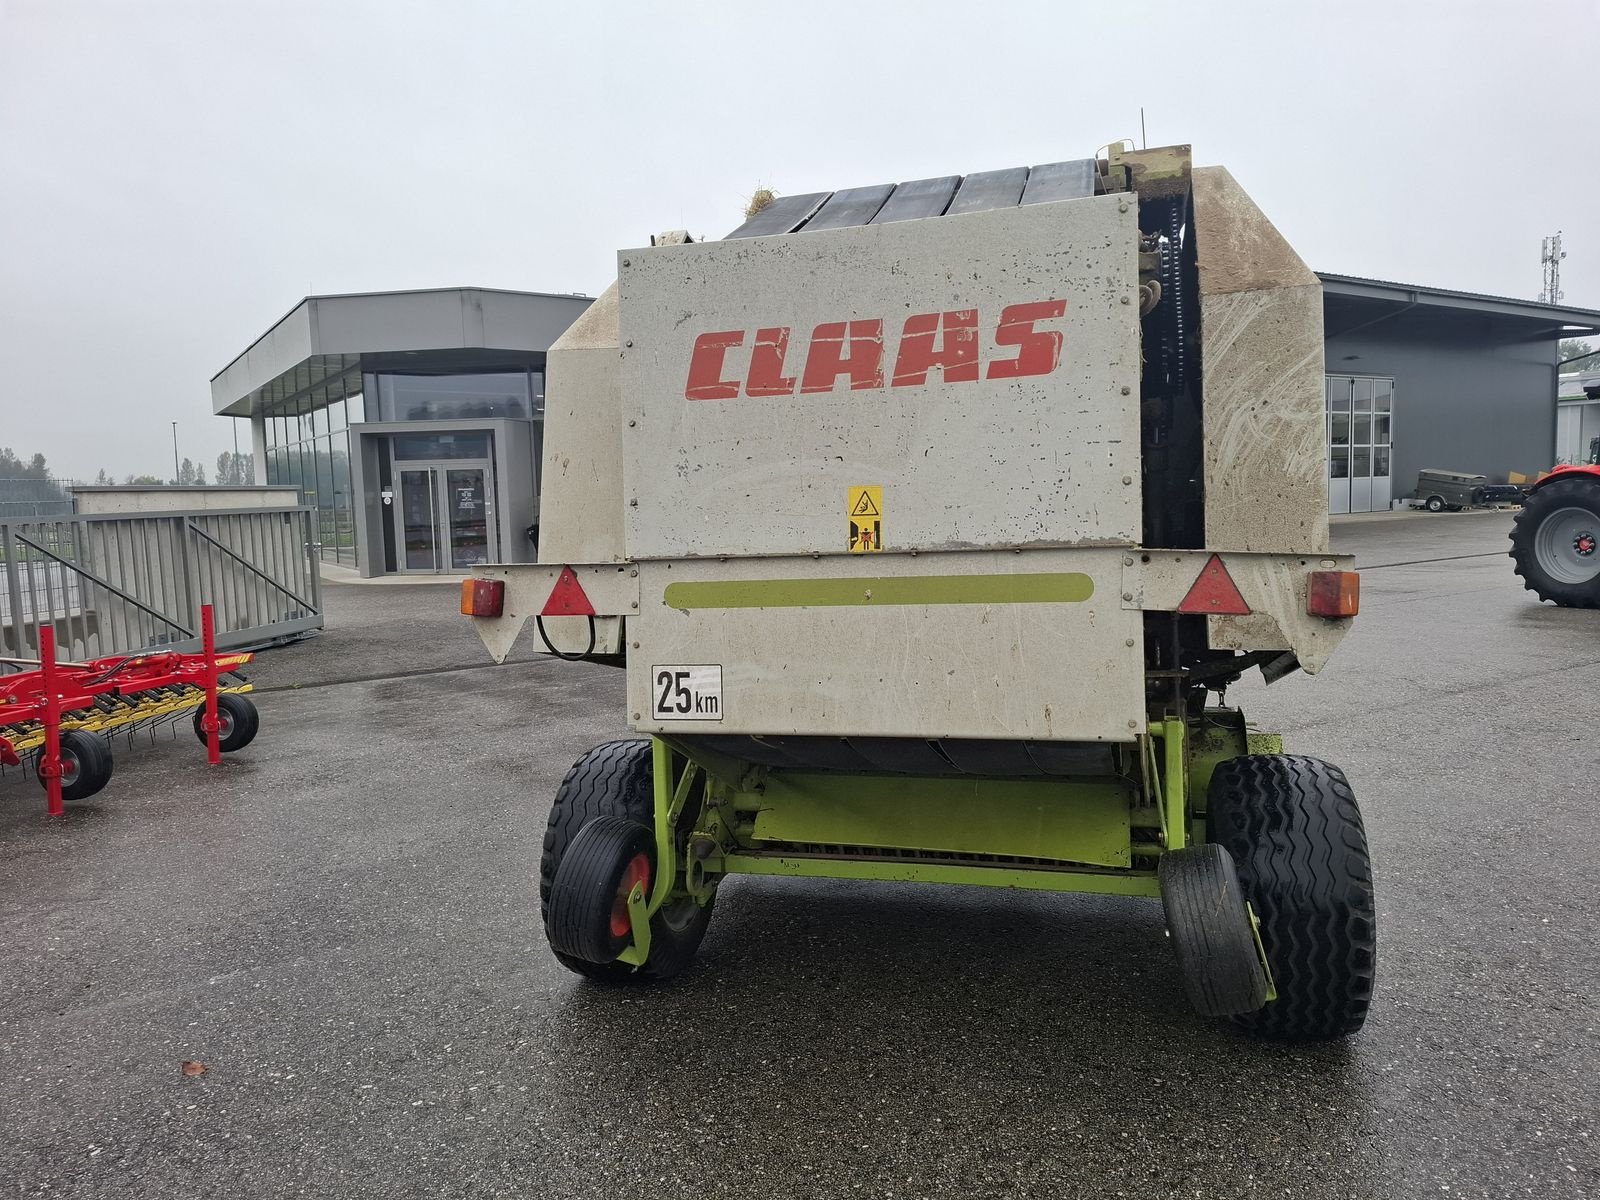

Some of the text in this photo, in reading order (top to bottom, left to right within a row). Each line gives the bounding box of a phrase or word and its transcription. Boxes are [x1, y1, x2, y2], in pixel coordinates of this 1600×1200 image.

[685, 299, 1067, 400] CLAAS
[657, 671, 718, 713] 25 km
